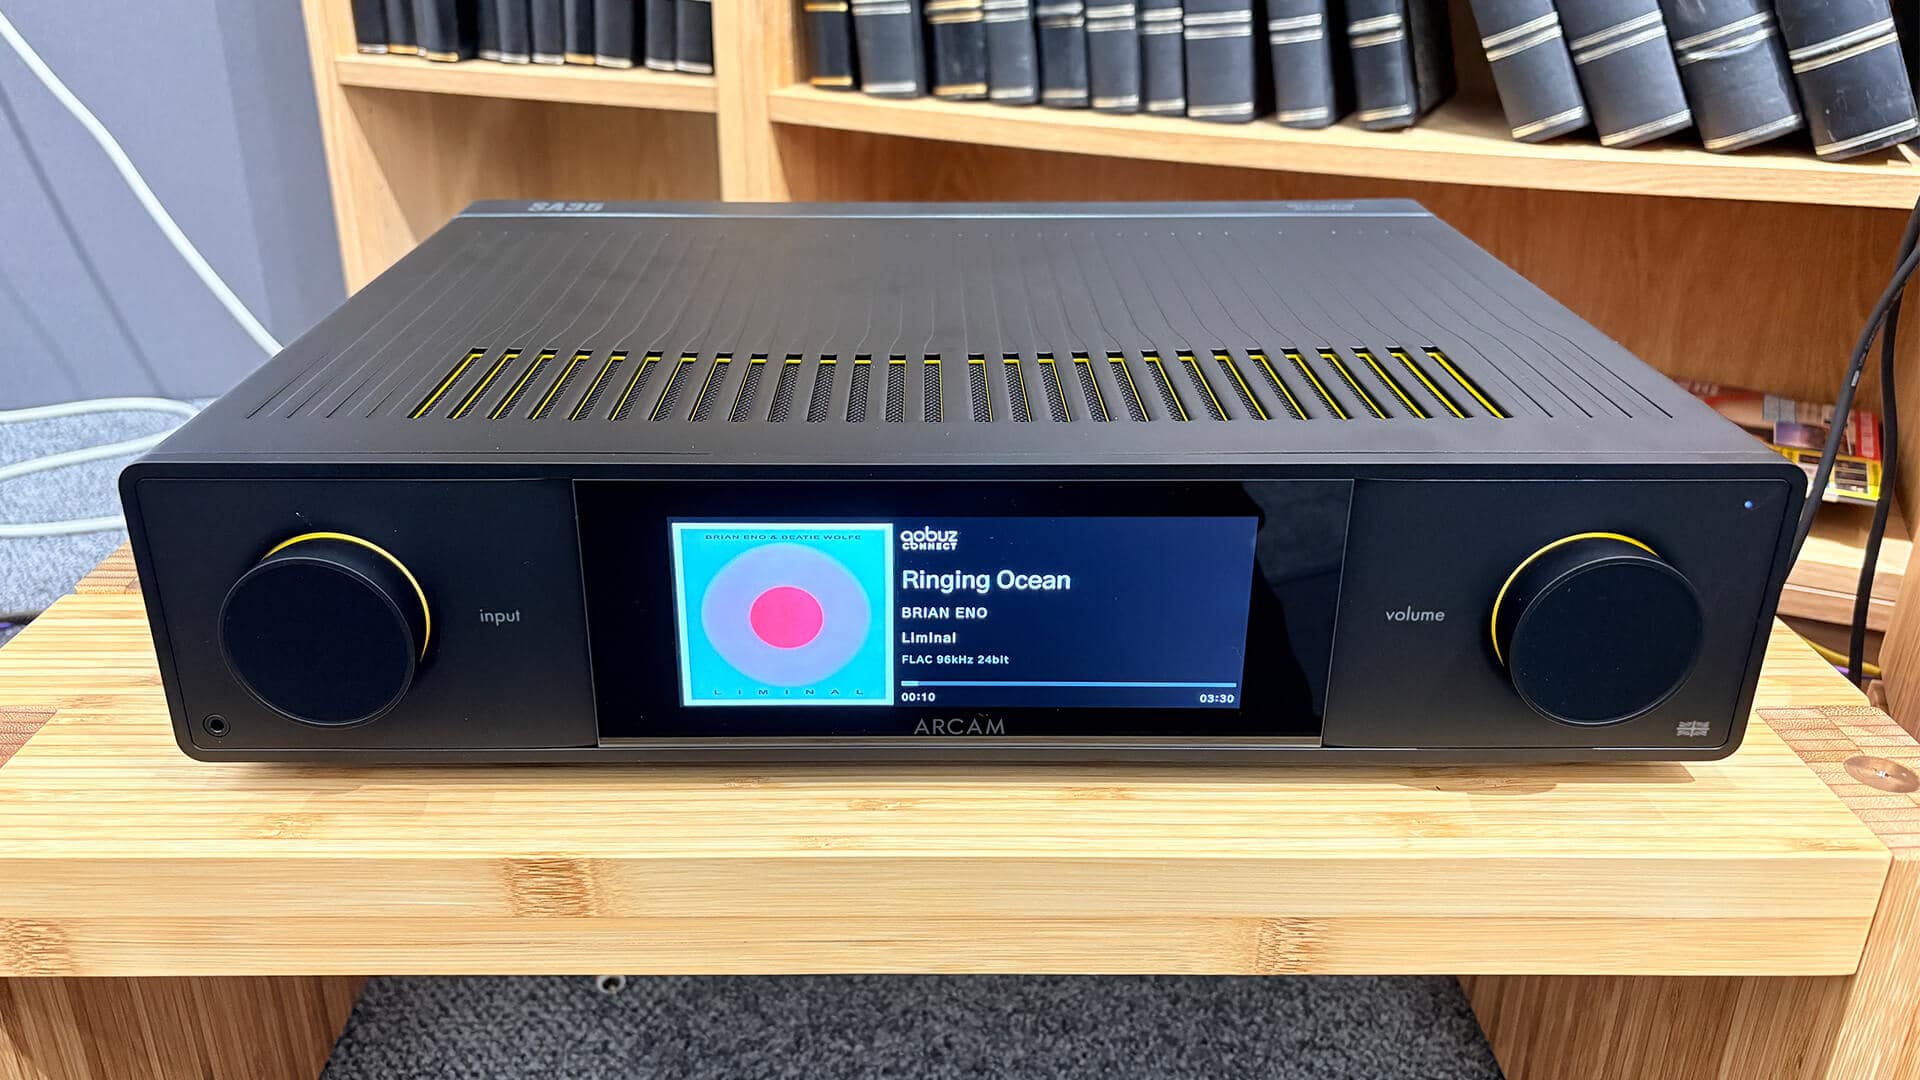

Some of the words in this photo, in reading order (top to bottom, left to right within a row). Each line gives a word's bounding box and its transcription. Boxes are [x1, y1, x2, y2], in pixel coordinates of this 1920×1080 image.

[900, 525, 959, 545] qobuz
[902, 542, 958, 551] CONNECT
[902, 569, 991, 594] Ringing
[996, 569, 1072, 590] Ocean
[479, 608, 520, 627] input
[901, 606, 950, 619] BRIAN
[955, 606, 989, 619] ENO
[1385, 605, 1446, 622] volume
[901, 631, 957, 644] Liminal
[901, 655, 933, 665] FLAC
[936, 655, 974, 665] 96kHz
[977, 655, 1010, 665] 24bit
[901, 692, 936, 702] 00:10
[1199, 693, 1234, 703] 03:30
[913, 717, 1005, 736] ARCAM
